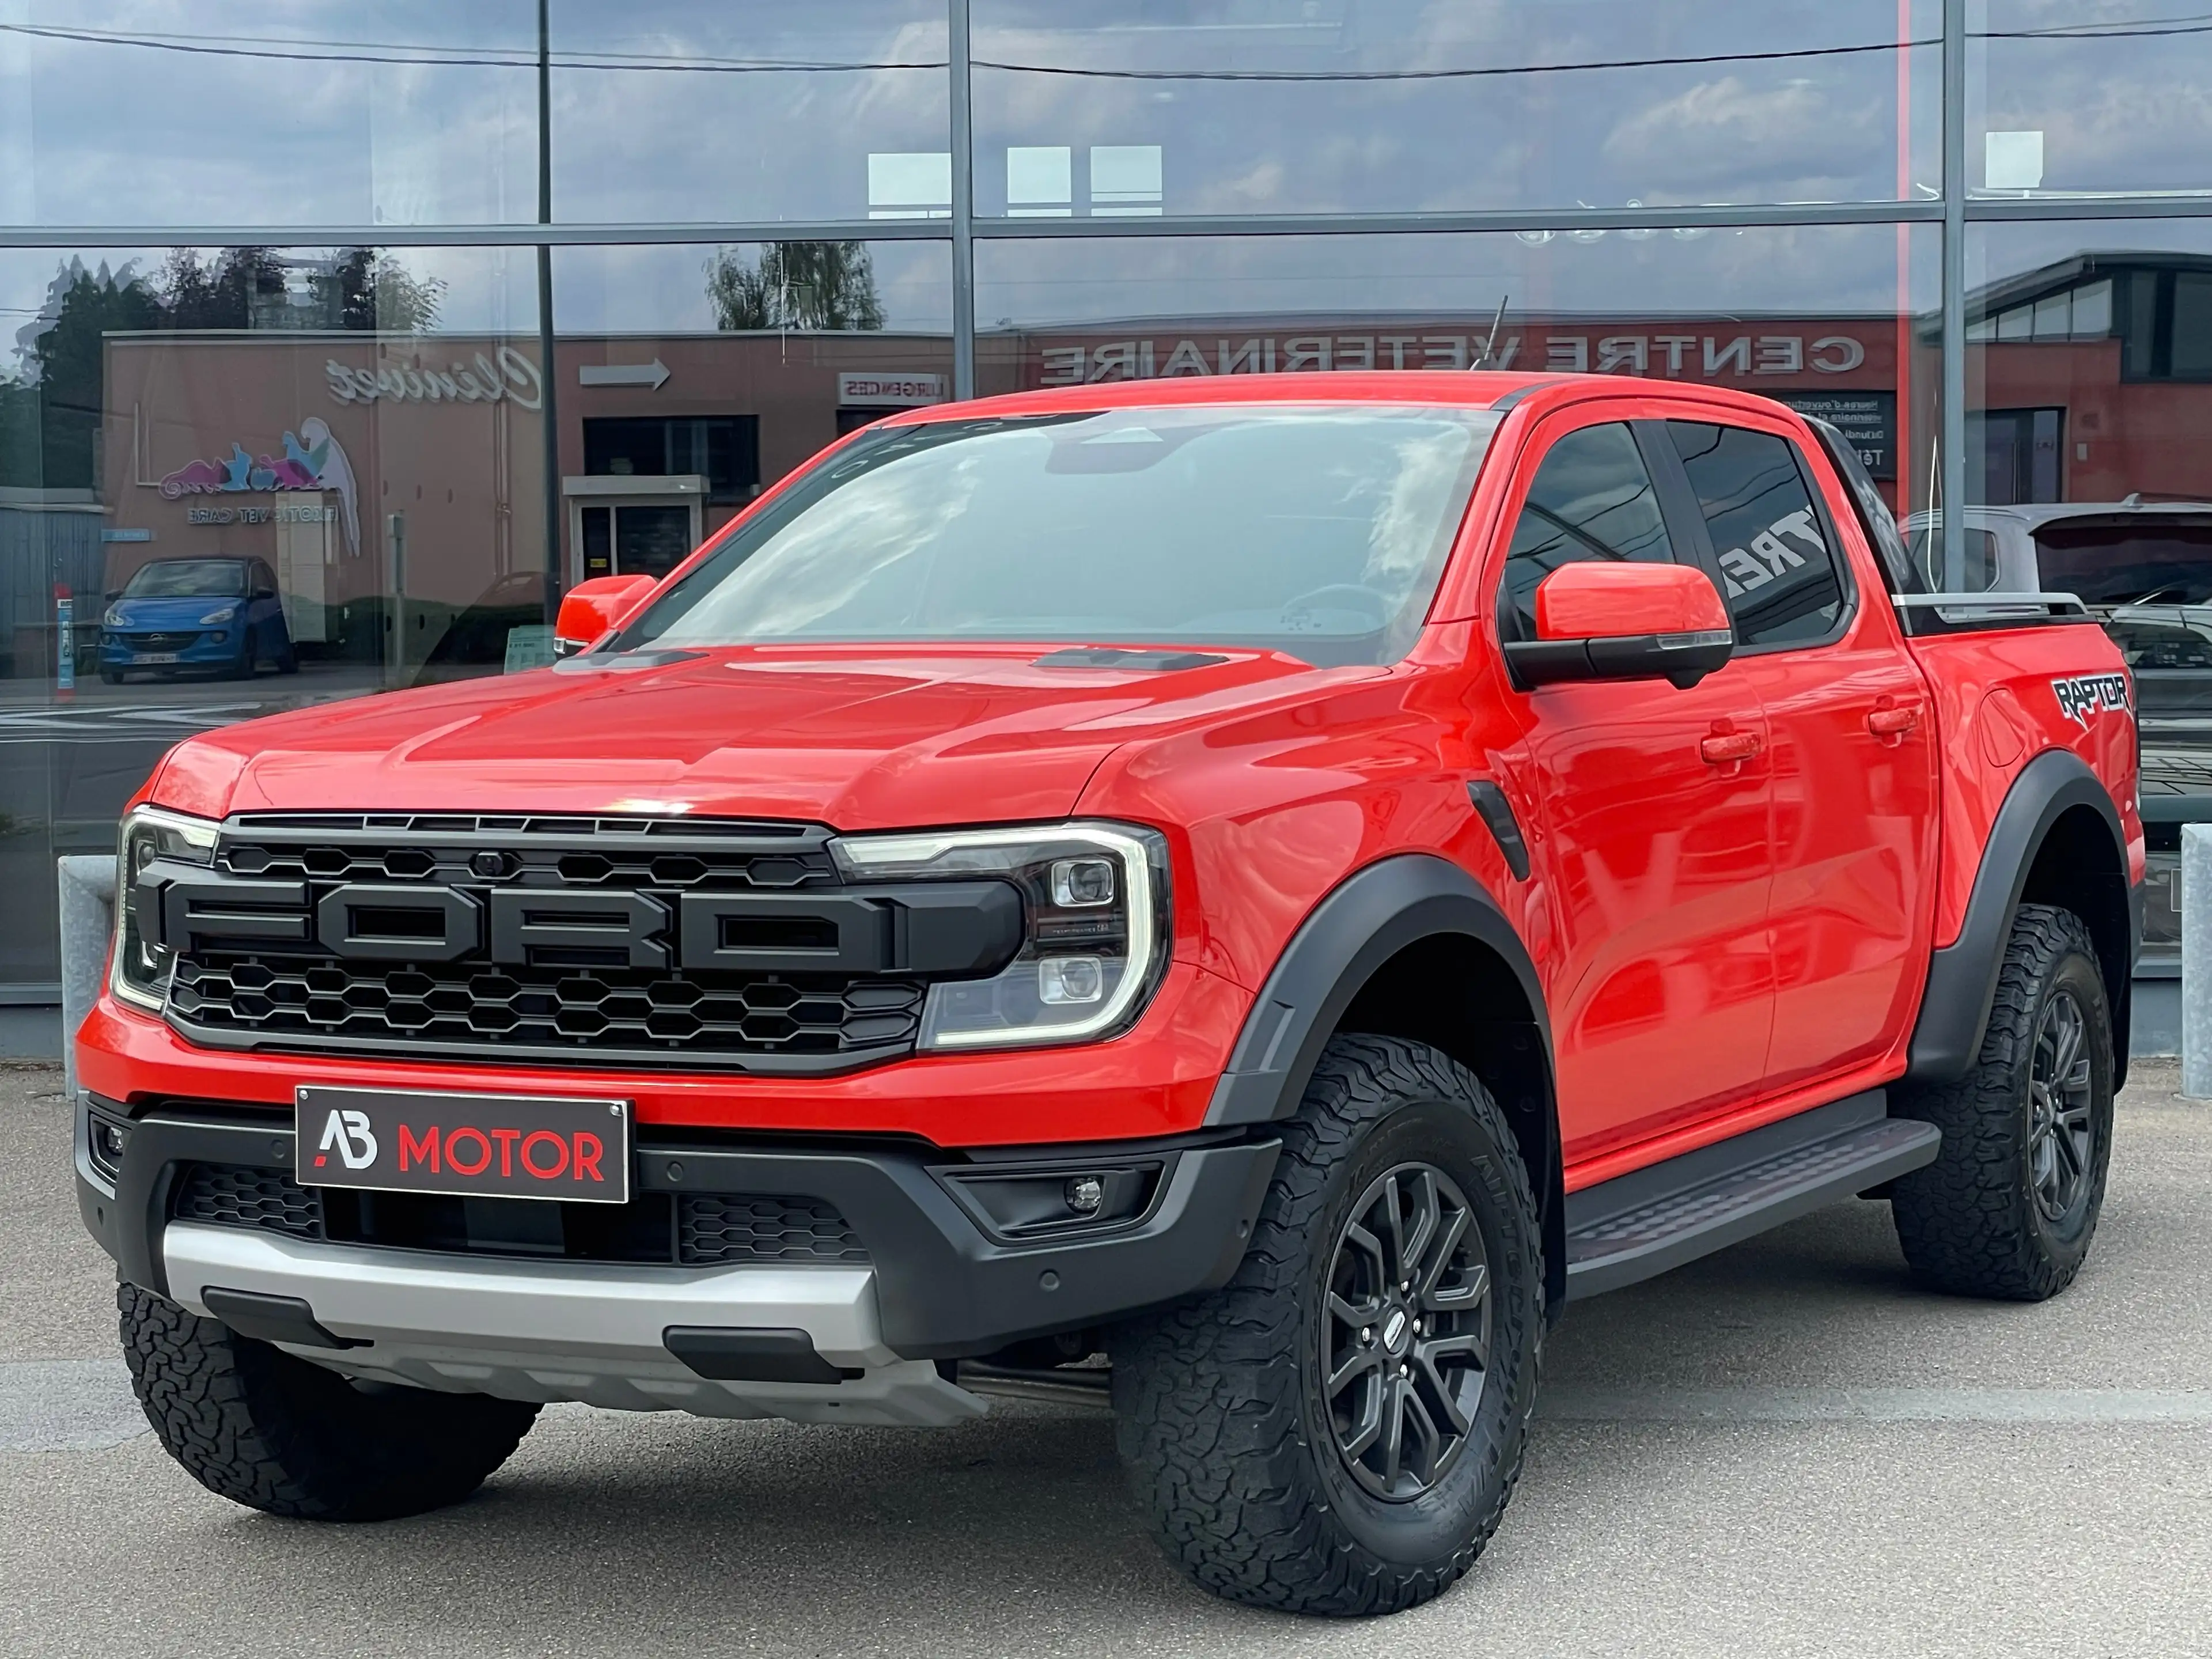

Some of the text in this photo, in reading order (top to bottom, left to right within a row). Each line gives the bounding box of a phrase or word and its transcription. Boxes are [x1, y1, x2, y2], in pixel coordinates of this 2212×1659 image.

[2051, 673, 2134, 729] RAPTOR
[164, 879, 890, 974] FORD
[314, 1109, 605, 1182] AB MOTOR
